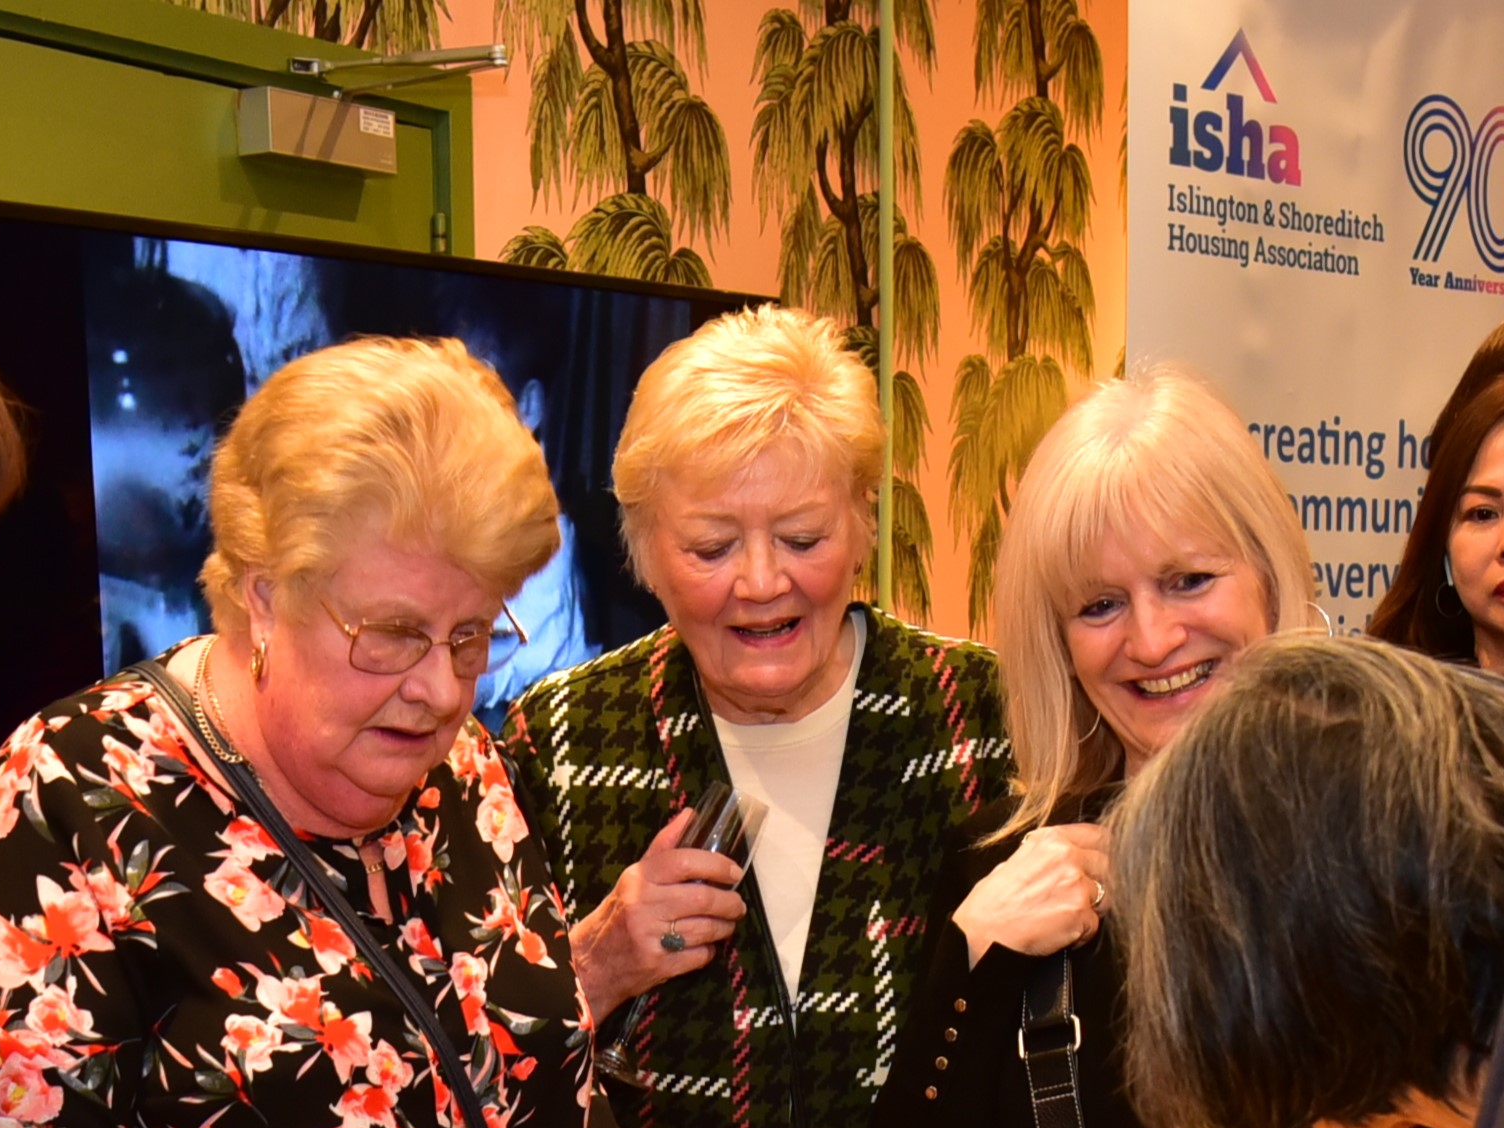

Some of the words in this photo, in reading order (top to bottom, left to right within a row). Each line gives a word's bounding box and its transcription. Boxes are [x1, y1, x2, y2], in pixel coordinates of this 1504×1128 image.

[1169, 82, 1302, 187] isha
[1168, 183, 1259, 227] Islington
[1263, 199, 1275, 227] &
[1279, 201, 1384, 242] Shoreditch
[1167, 223, 1250, 268] Housing
[1253, 235, 1360, 276] Association
[1409, 266, 1441, 288] Year
